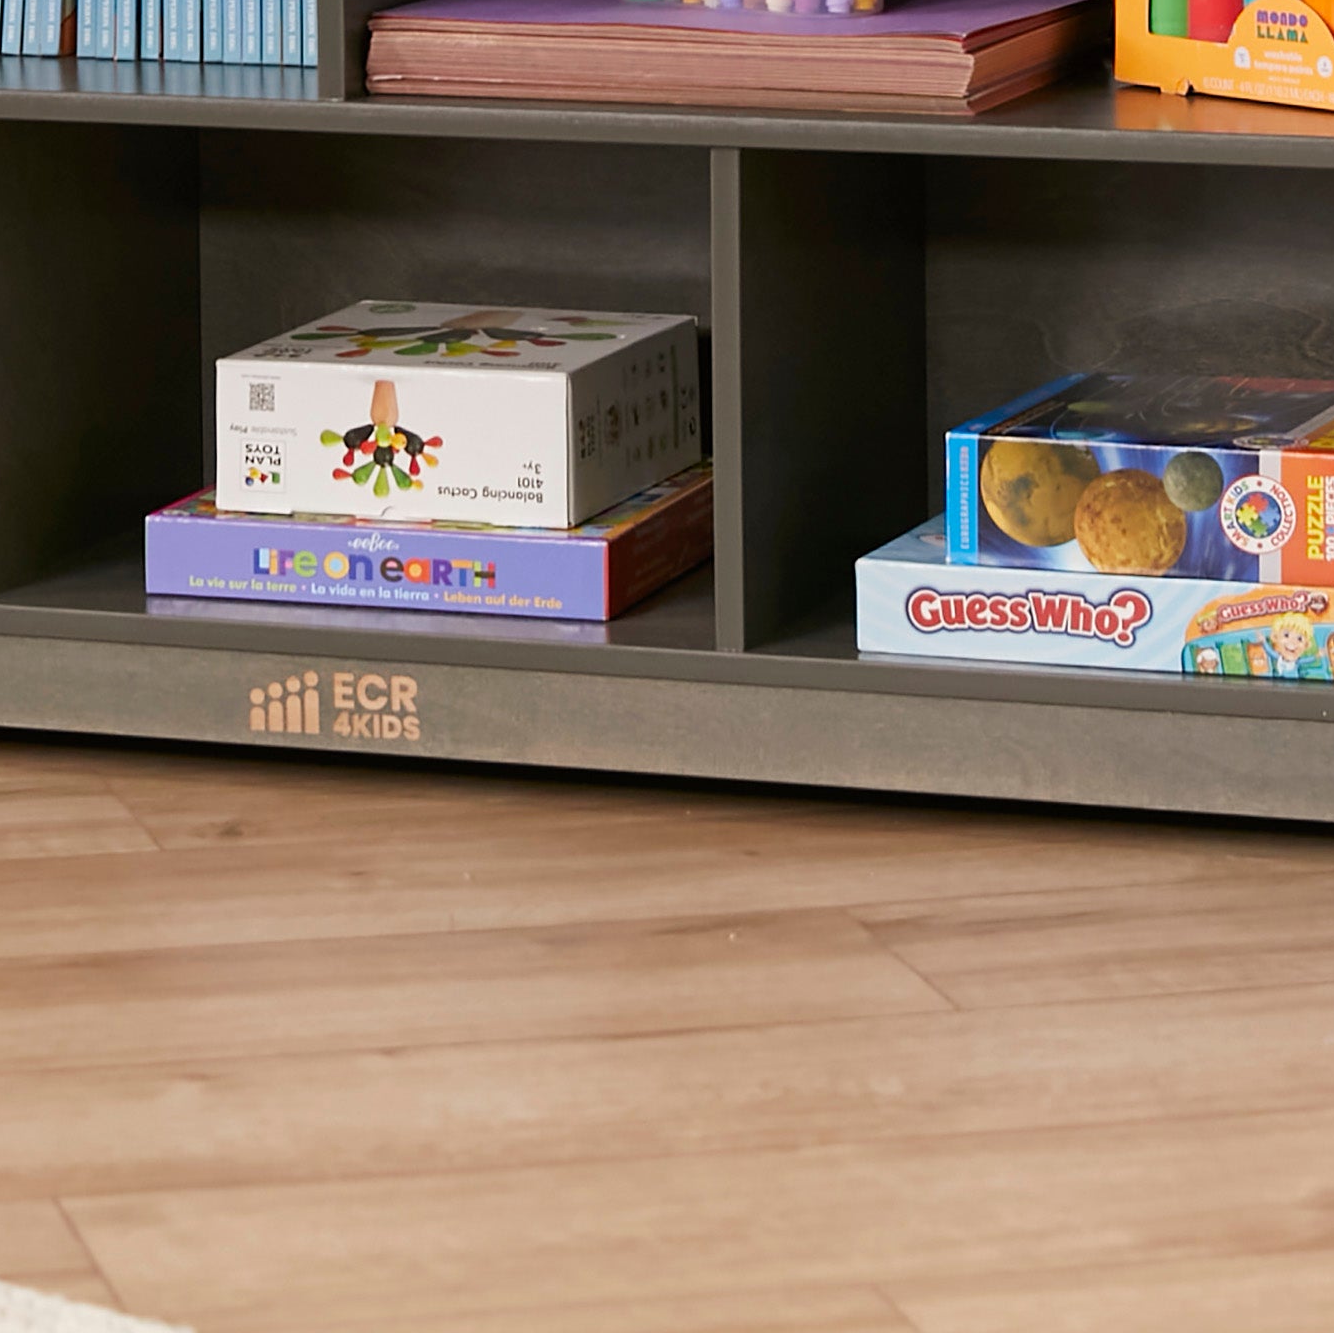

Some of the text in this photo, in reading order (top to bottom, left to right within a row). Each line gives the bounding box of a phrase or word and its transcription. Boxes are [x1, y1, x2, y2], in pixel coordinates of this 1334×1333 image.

[229, 423, 297, 437] Sustainable Play
[245, 443, 282, 455] TOYS
[245, 455, 282, 467] PLAN
[437, 486, 543, 503] Balancing Cactus
[516, 477, 543, 488] 4101
[1223, 480, 1249, 548] SMART KIDS
[1270, 484, 1294, 547] COLLECTION
[1307, 475, 1325, 561] PUZZLE
[323, 551, 373, 581] on
[189, 575, 563, 610] La vie sur la terre La vida en la tierra Leben auf der Erde
[1219, 591, 1309, 623] Guess Who?
[908, 589, 1150, 645] Guess Who?
[333, 672, 418, 713] ECR
[332, 711, 420, 741] 4KIDS
